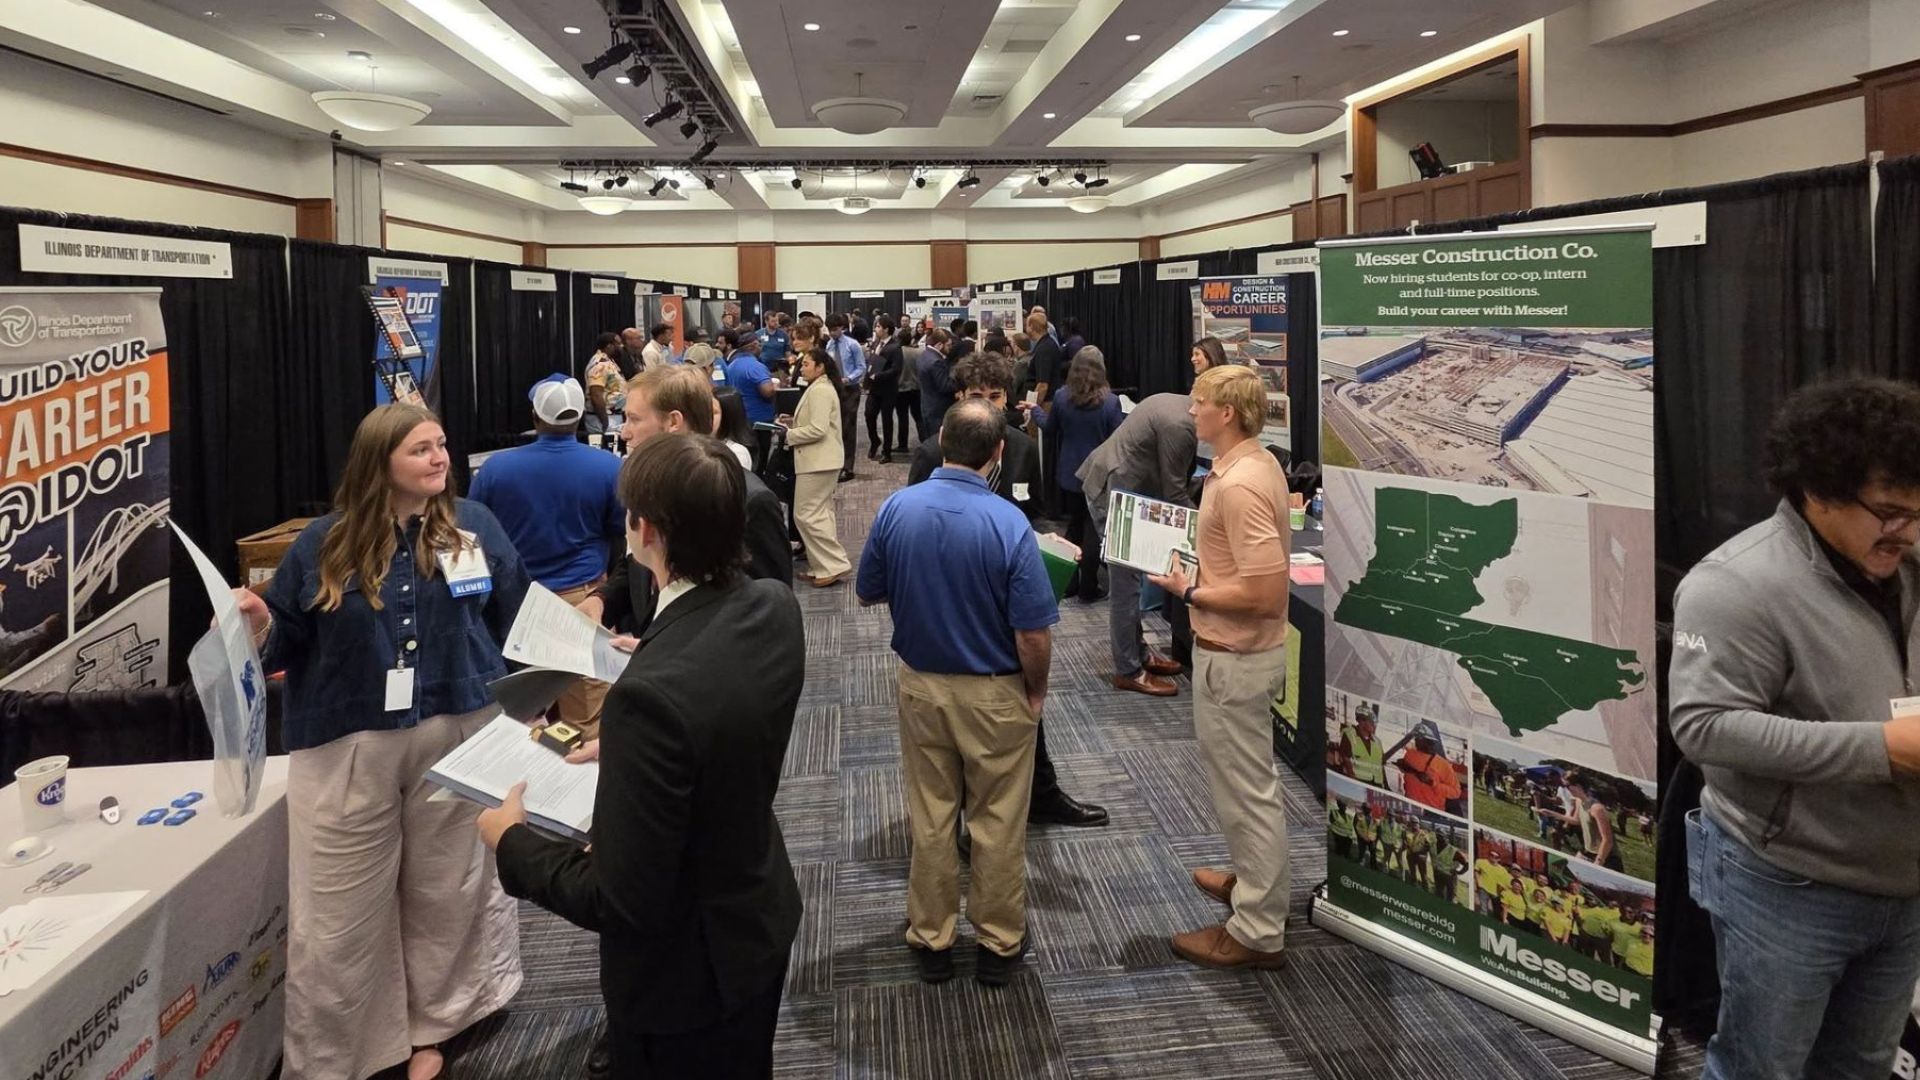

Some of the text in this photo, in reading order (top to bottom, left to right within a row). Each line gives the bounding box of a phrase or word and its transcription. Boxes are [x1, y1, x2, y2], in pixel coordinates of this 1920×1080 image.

[45, 241, 211, 264] ILLINOIS DEPARTMENT OF TRANSPORTATION
[1355, 242, 1598, 266] Messer Construction Co.
[1233, 285, 1285, 293] CONSTRUCTION
[1363, 270, 1587, 285] Now hiring students for co-op, intern
[1233, 292, 1286, 304] CAREER
[1399, 286, 1540, 298] and full-time positions.
[38, 313, 132, 327] Illinois Department
[1204, 304, 1286, 314] OPPORTUNITIES
[1378, 305, 1567, 317] Build your career with Messer!
[38, 325, 123, 338] of Transportation
[72, 340, 146, 378] YOUR
[0, 371, 150, 479] AREER
[0, 434, 147, 542] @IDOT
[456, 581, 486, 593] ALUMNI
[1340, 875, 1455, 932] @messerwearebldg
[1383, 906, 1456, 944] messer.com
[1480, 925, 1640, 1009] Messer
[1481, 955, 1570, 1000] WeAreBuilding.
[26, 969, 149, 1080] NGINEERING
[53, 1017, 119, 1080] CTION
